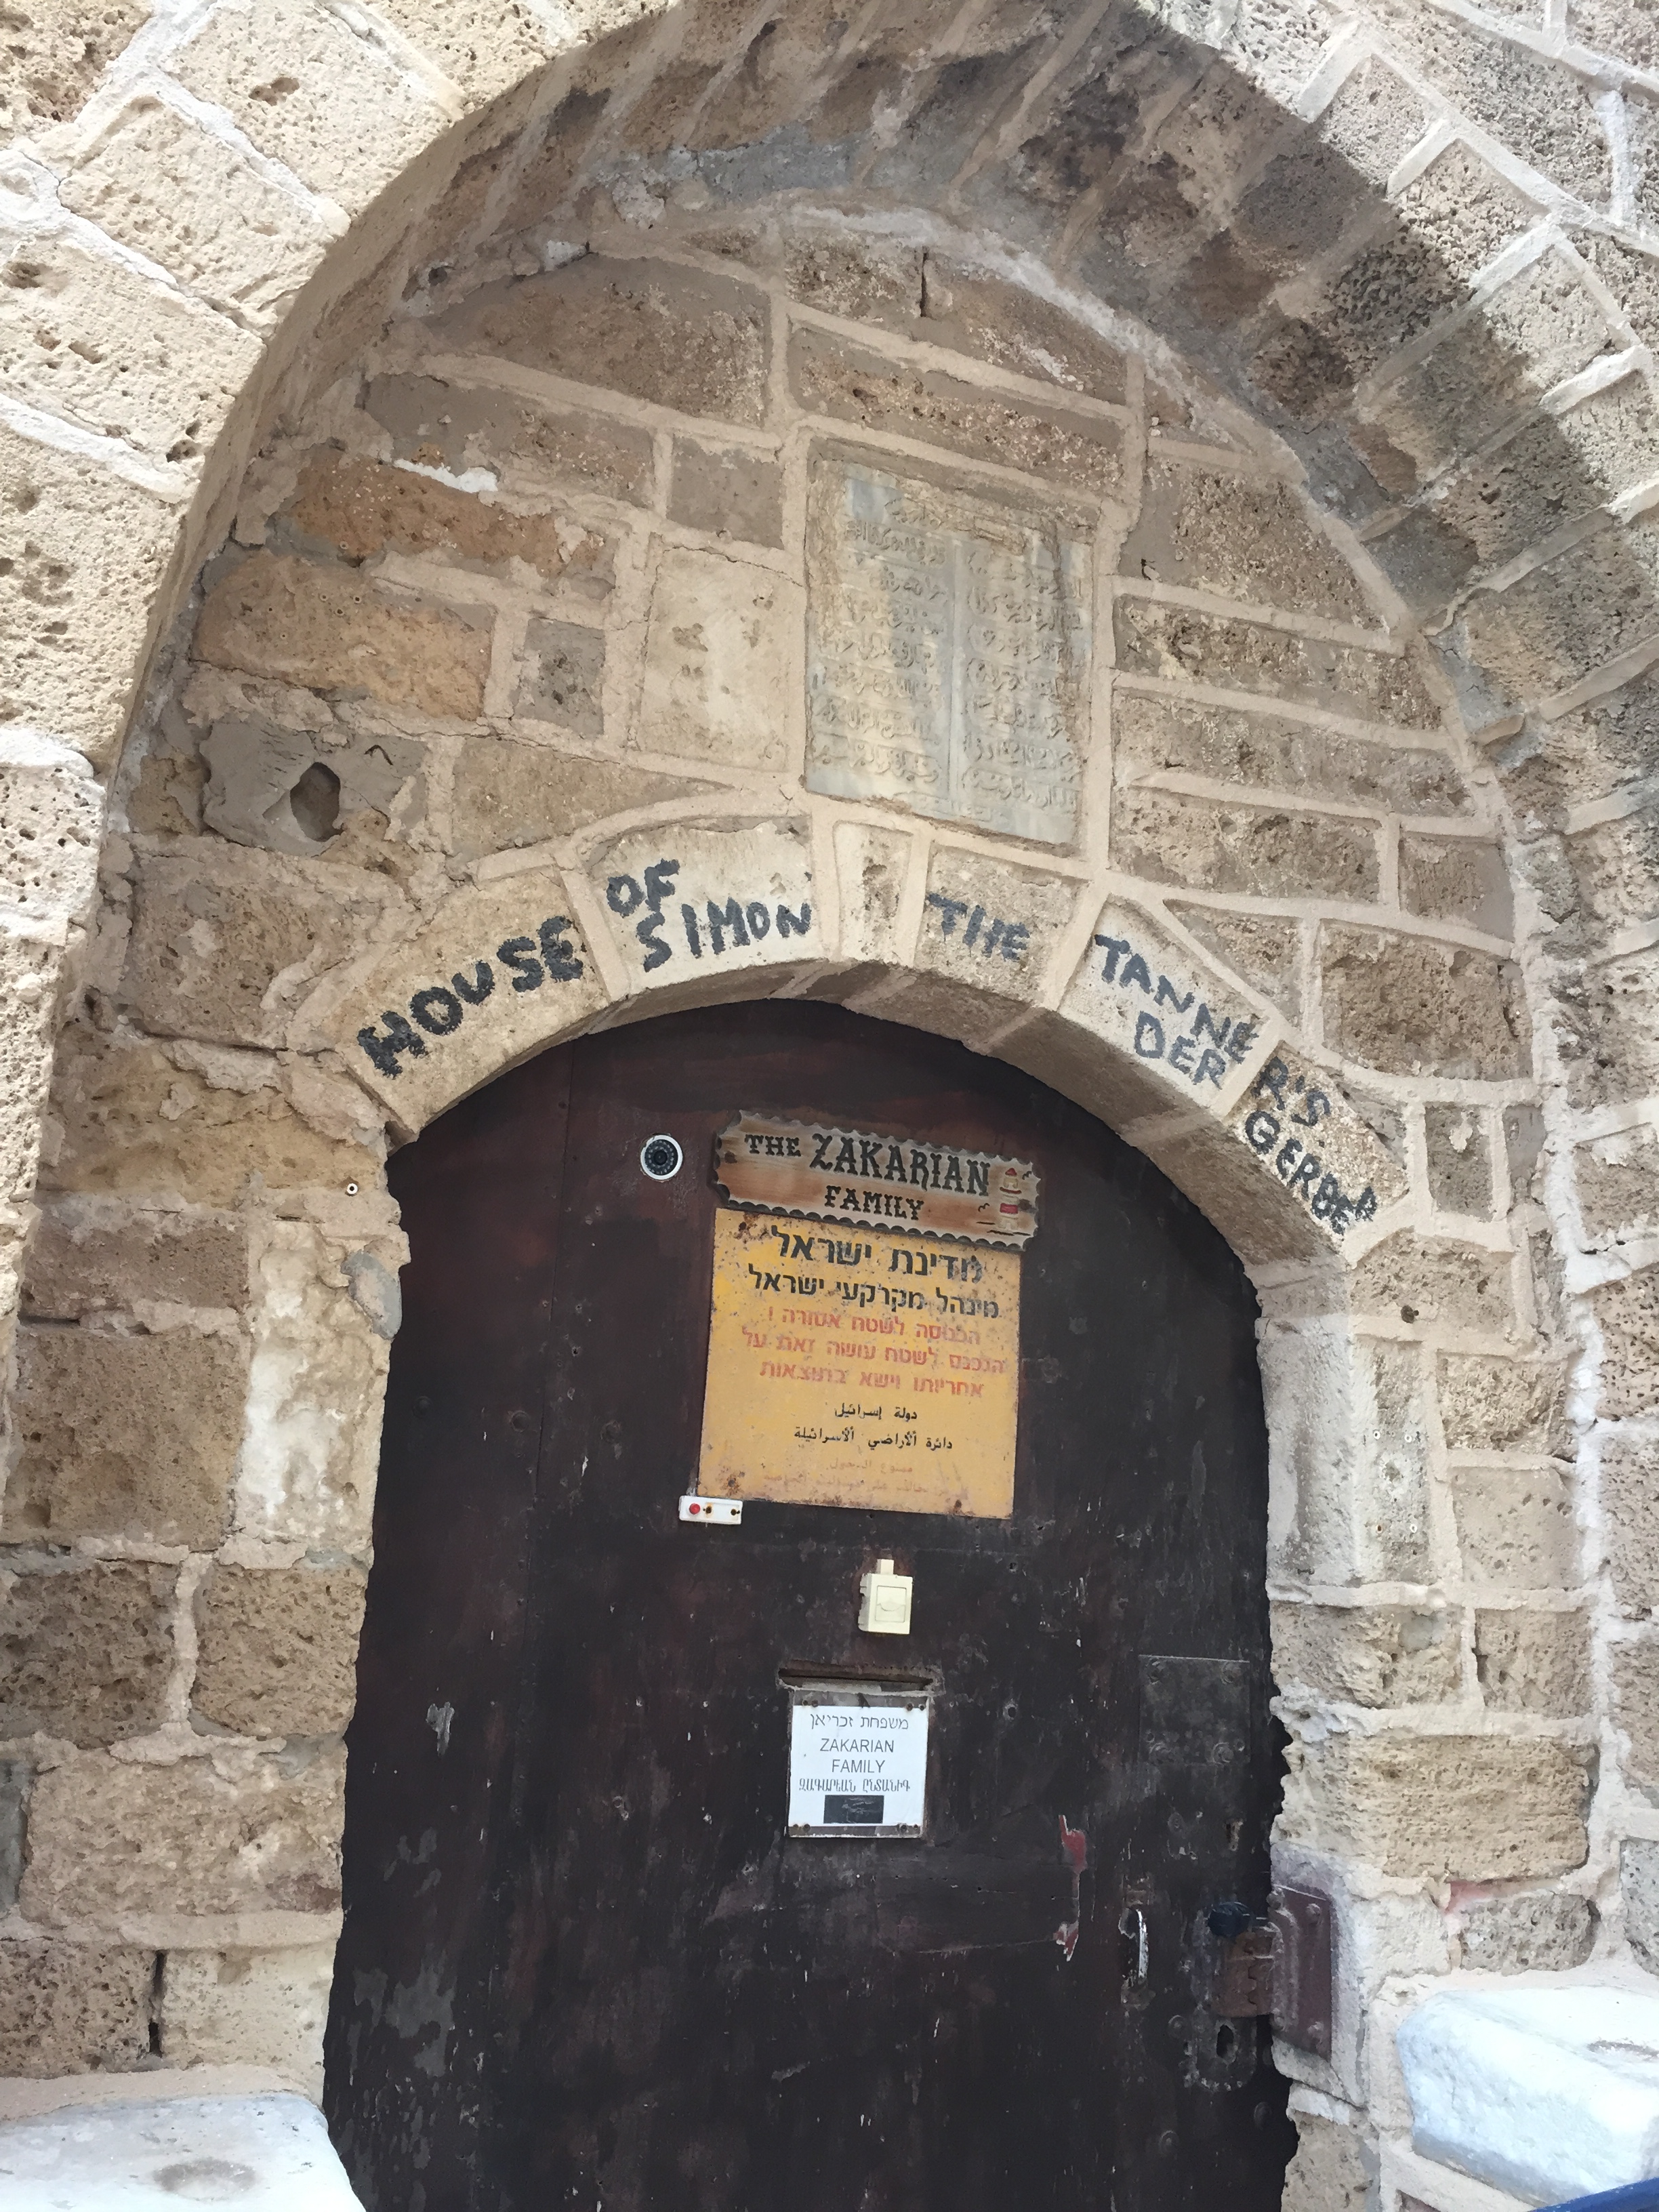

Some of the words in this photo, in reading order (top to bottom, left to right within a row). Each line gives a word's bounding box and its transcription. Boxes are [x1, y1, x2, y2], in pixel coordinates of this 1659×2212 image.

[607, 859, 680, 916] OF
[636, 896, 812, 972] SIMON
[926, 893, 1030, 962] THE
[357, 915, 583, 1079] HOUSE
[1134, 1010, 1227, 1090] DER
[1245, 1110, 1377, 1235] GERBER
[744, 1134, 802, 1158] THE
[809, 1132, 991, 1197] ZAKARIAN
[823, 1185, 925, 1221] FAMILY
[771, 1225, 872, 1266] ישראל
[888, 1248, 982, 1284] מדינת
[748, 1263, 825, 1296] ישראל
[836, 1280, 927, 1313] מקרקעי
[935, 1286, 999, 1319] מינהל
[782, 1308, 842, 1328] אסורה
[851, 1315, 905, 1336] לשטח
[742, 1325, 767, 1348] על
[777, 1335, 816, 1353] זאת
[827, 1340, 876, 1359] עושה
[884, 1347, 939, 1368] לשטח
[949, 1354, 1004, 1374] הנכנס
[859, 1370, 901, 1389] וישא
[914, 1377, 984, 1398] אחריותו
[894, 1406, 918, 1422] دولة
[926, 1436, 953, 1452] دائرة
[810, 1713, 853, 1730] זכריאן
[860, 1716, 909, 1729] משפחת
[819, 1738, 895, 1753] ZAKARIAN
[832, 1759, 885, 1774] FAMILY
